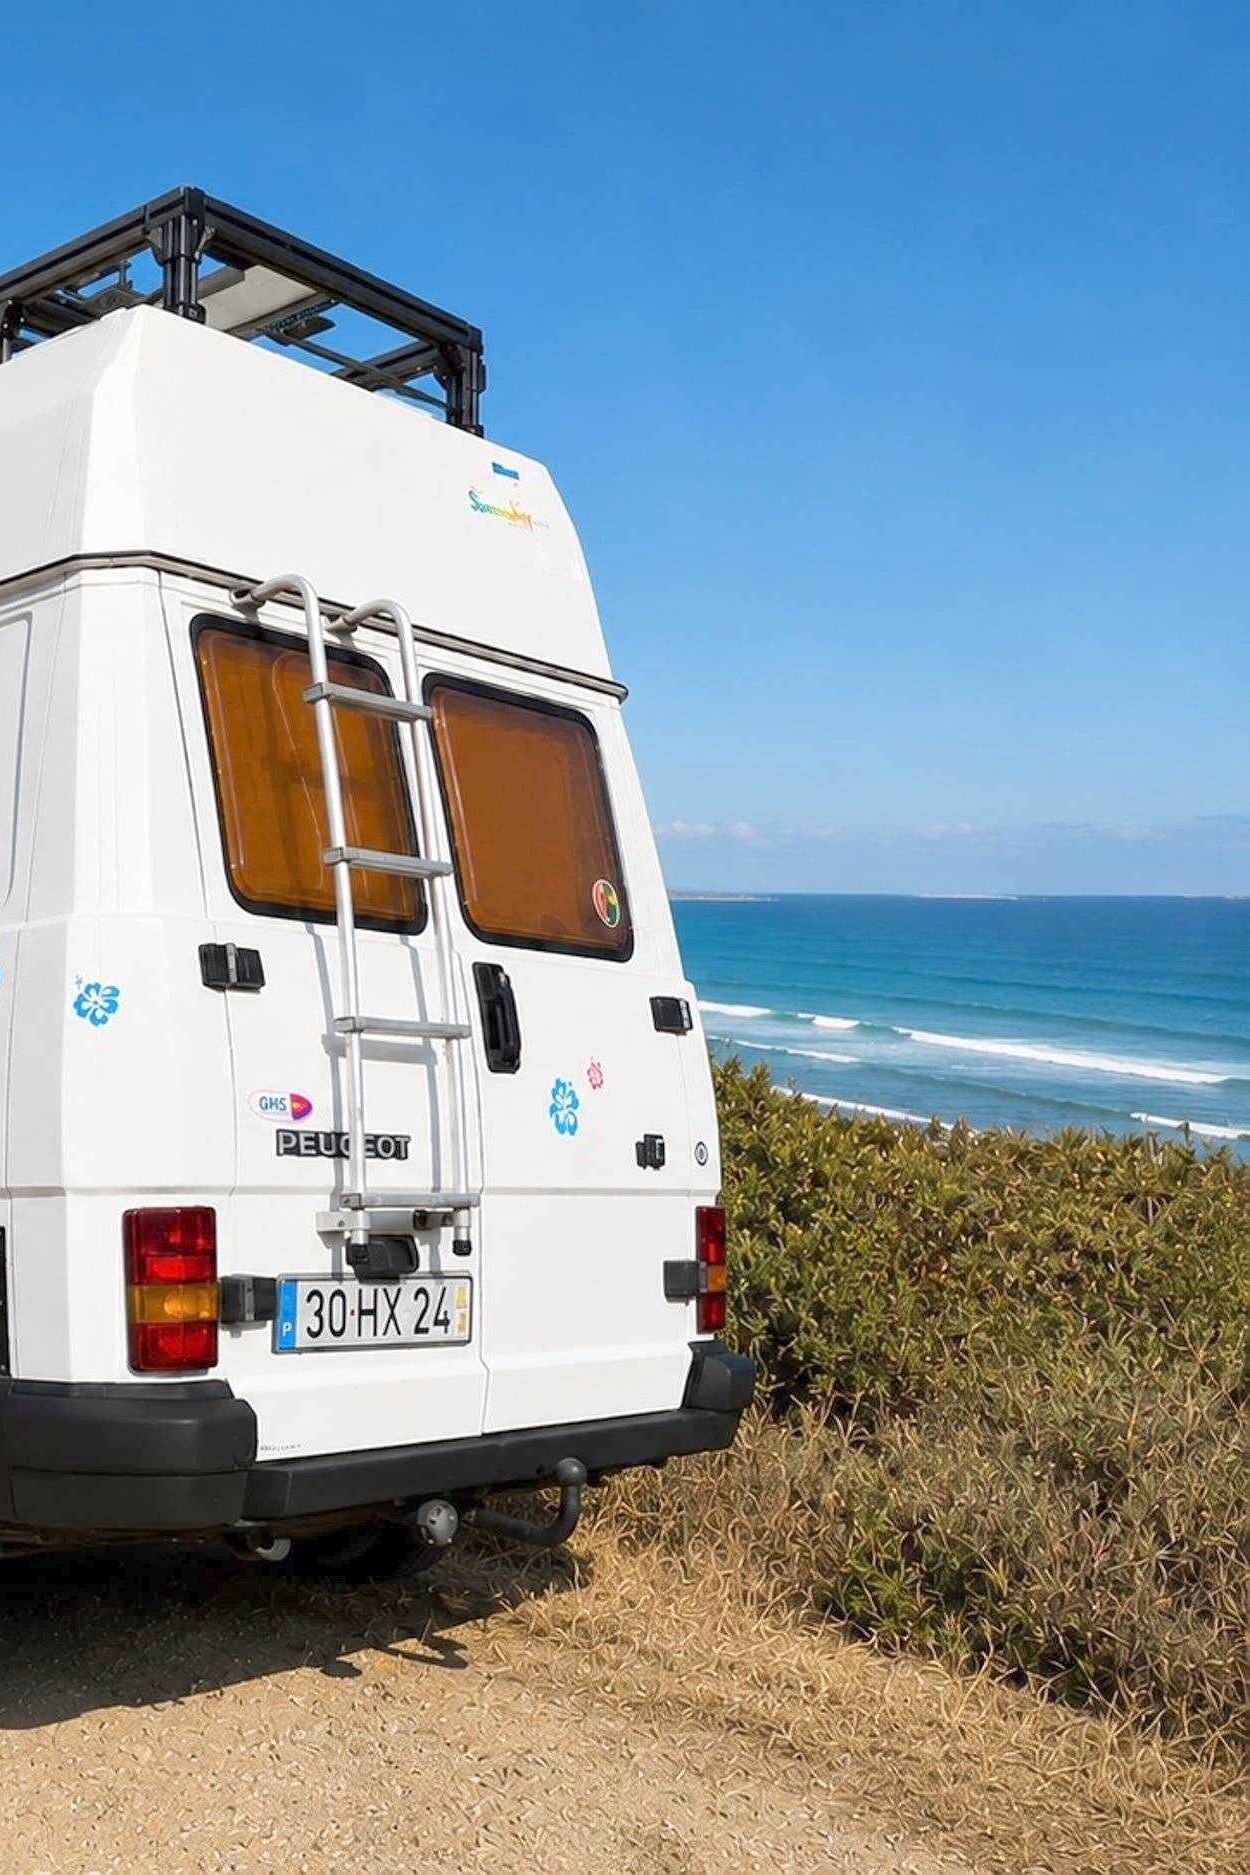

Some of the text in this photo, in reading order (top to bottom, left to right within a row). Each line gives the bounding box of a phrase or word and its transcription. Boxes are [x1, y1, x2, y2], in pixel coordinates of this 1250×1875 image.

[258, 1096, 287, 1111] GHS
[306, 1288, 347, 1338] 30
[357, 1287, 402, 1337] HX
[413, 1286, 450, 1335] 24
[282, 1322, 293, 1337] P
